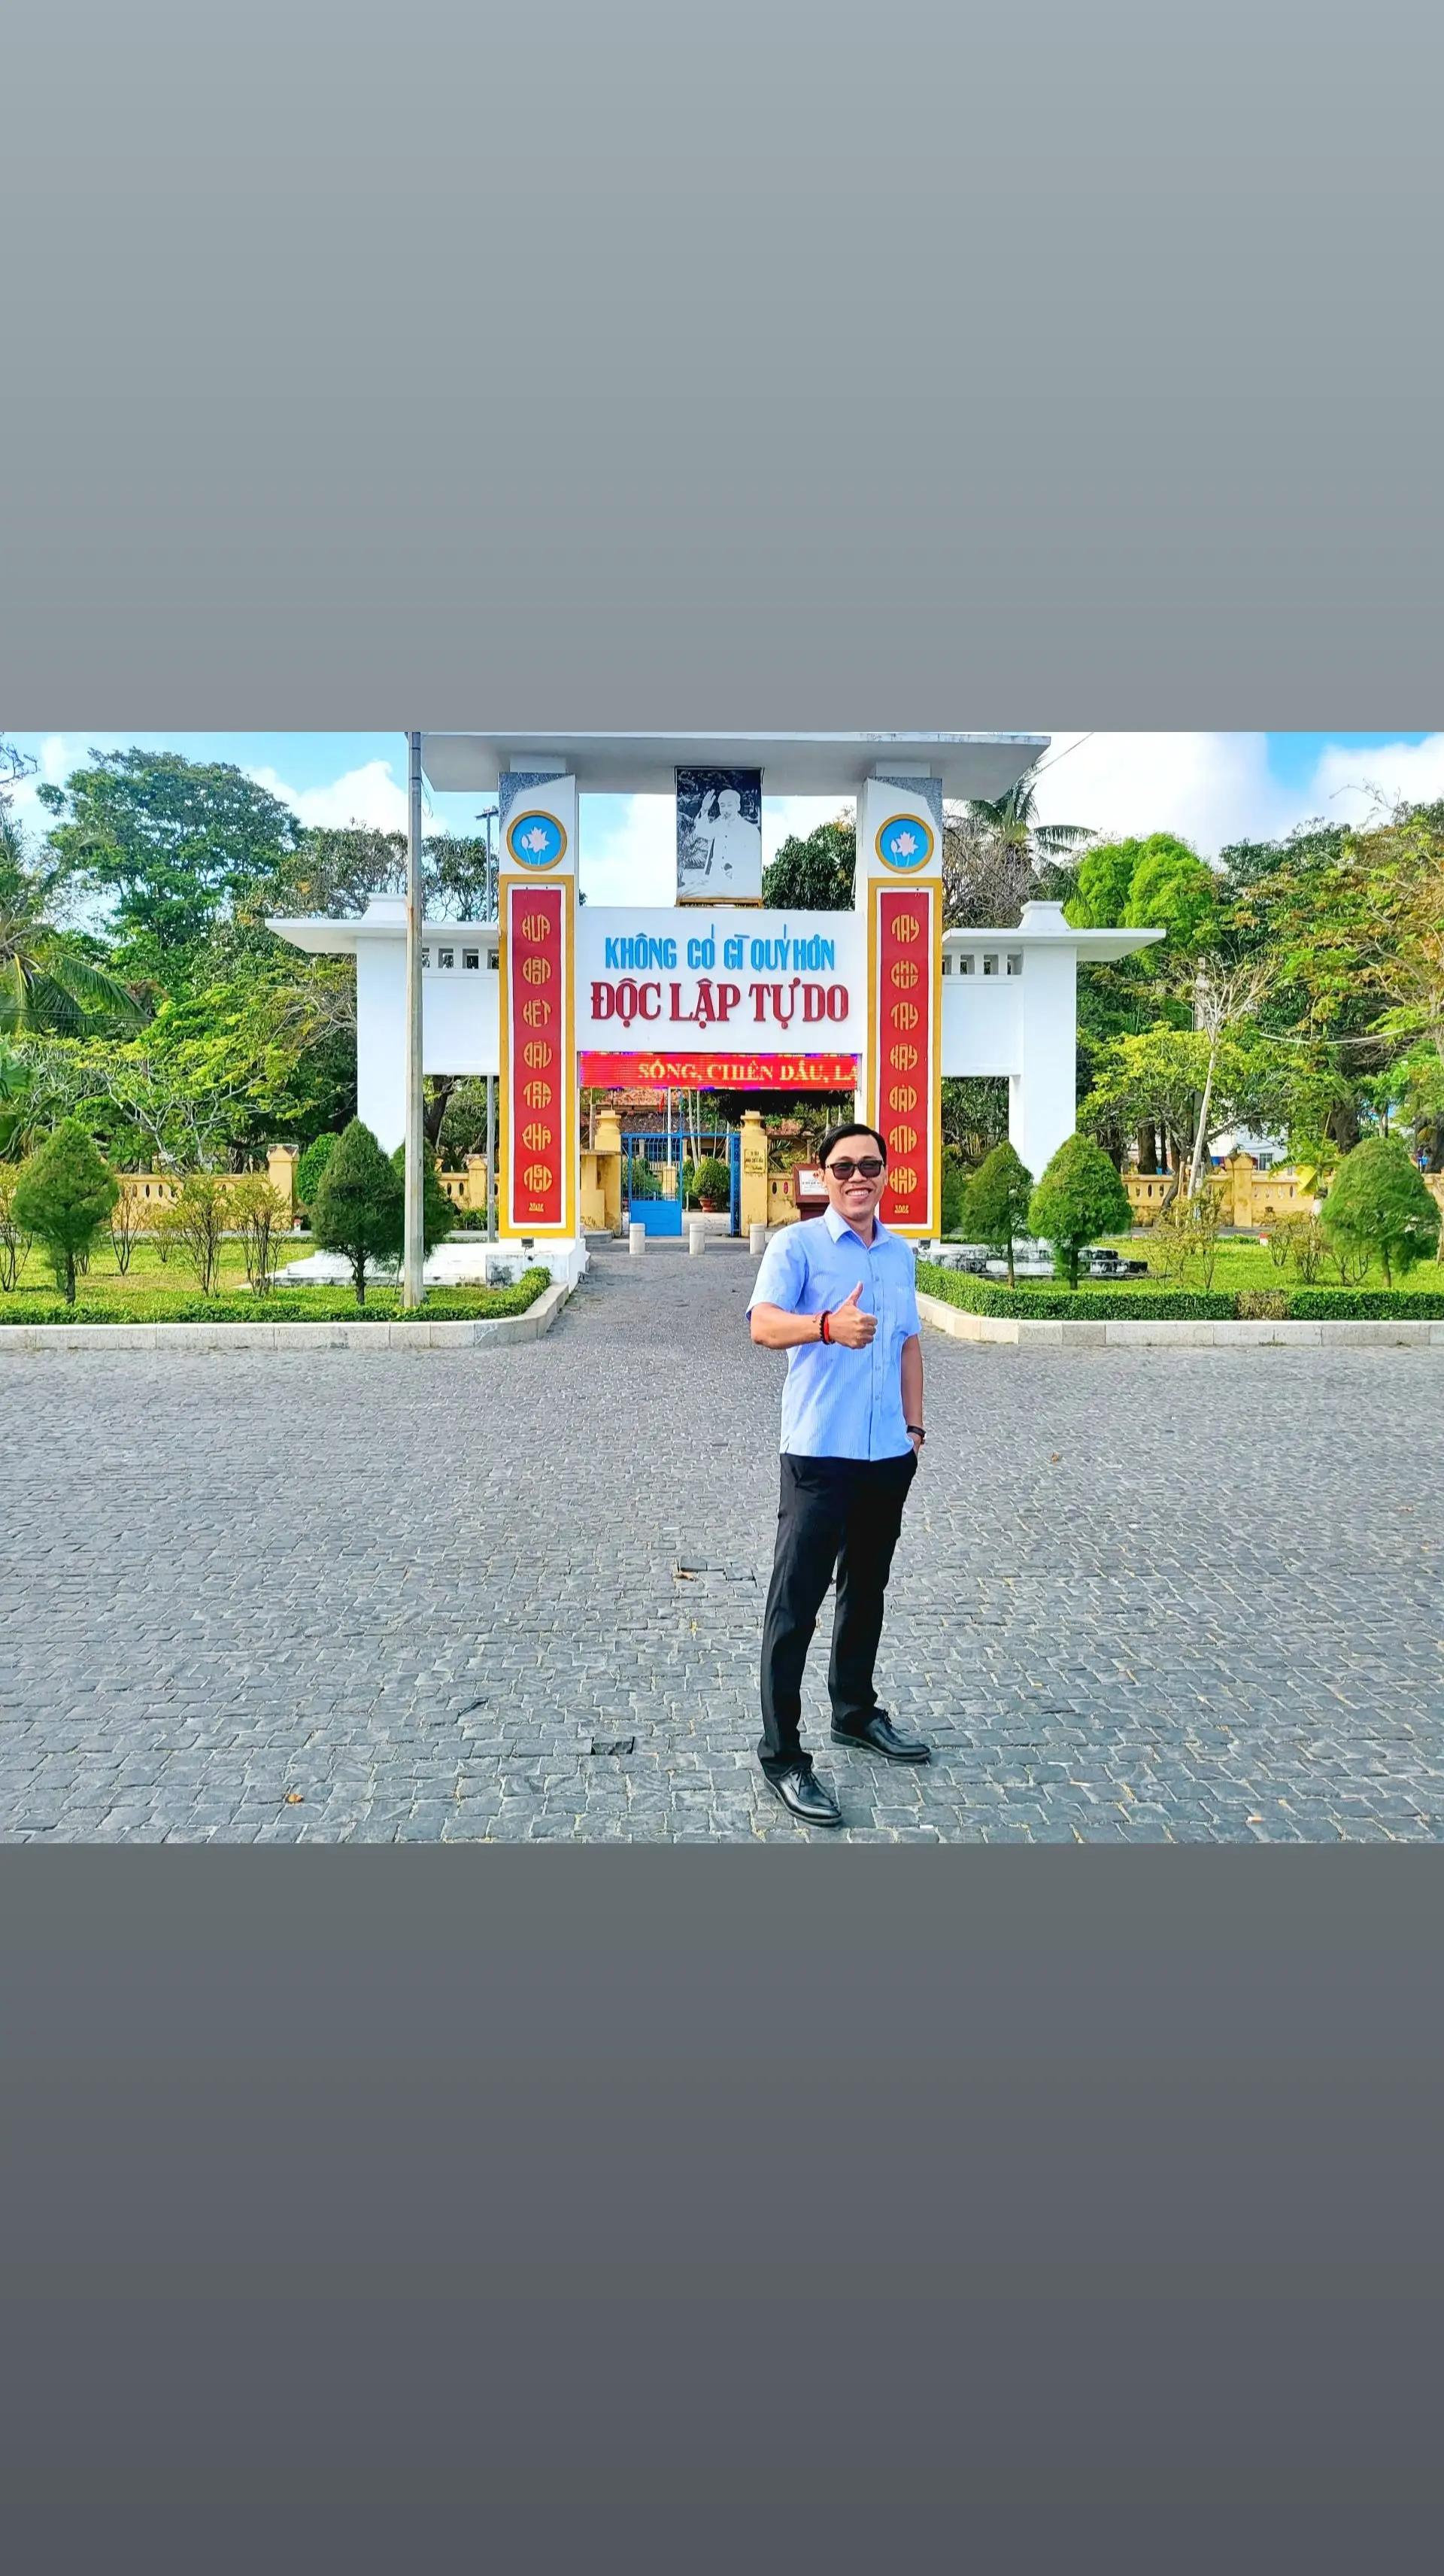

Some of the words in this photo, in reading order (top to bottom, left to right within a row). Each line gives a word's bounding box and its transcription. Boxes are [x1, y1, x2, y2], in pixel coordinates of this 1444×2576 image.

[605, 932, 677, 970] KHÔNG
[687, 924, 716, 970] CÓ
[724, 934, 750, 971] GÌ
[751, 924, 791, 972] QUÝ
[793, 934, 835, 971] HƠN
[523, 999, 551, 1028] KẾT
[590, 977, 661, 1028] ĐỘC
[669, 978, 741, 1029] LẬP
[748, 977, 801, 1030] TỰ
[802, 983, 849, 1022] DO
[890, 1002, 918, 1030] TAY
[522, 1122, 551, 1151] PHÁ
[889, 1125, 917, 1153] ANH
